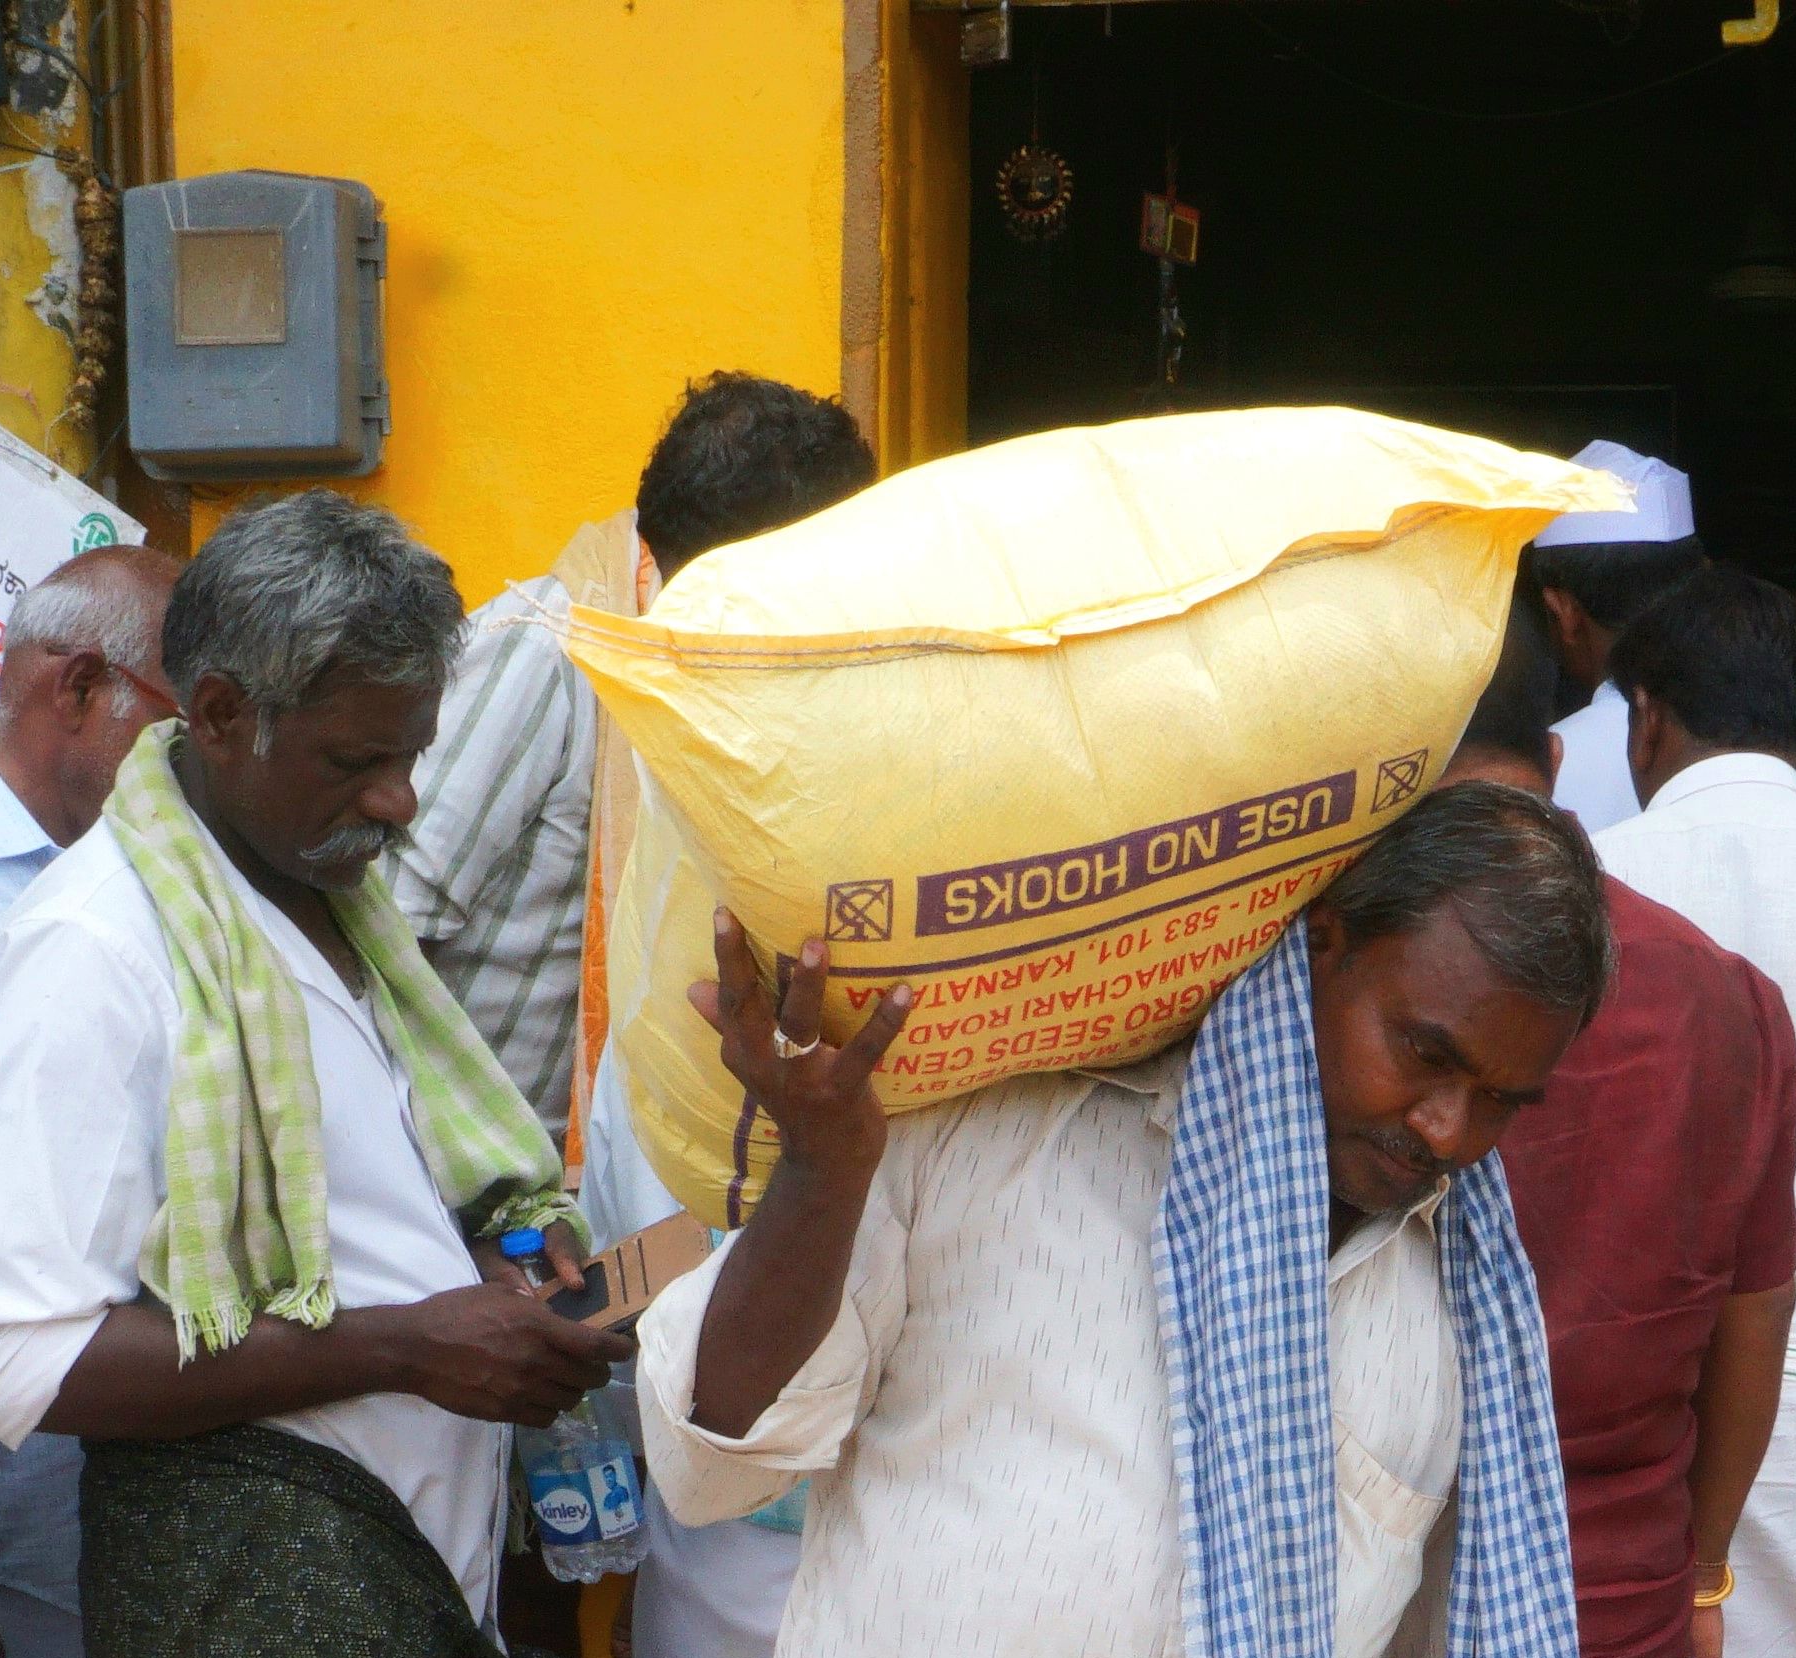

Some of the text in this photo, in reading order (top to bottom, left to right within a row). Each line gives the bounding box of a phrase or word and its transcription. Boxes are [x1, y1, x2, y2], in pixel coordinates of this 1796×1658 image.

[945, 786, 1333, 924] USE NO HOOKS
[1164, 904, 1221, 944] 583
[844, 951, 1077, 1011] KARNATAA
[985, 1013, 1116, 1064] SEEDS
[539, 1501, 587, 1520] kinley
